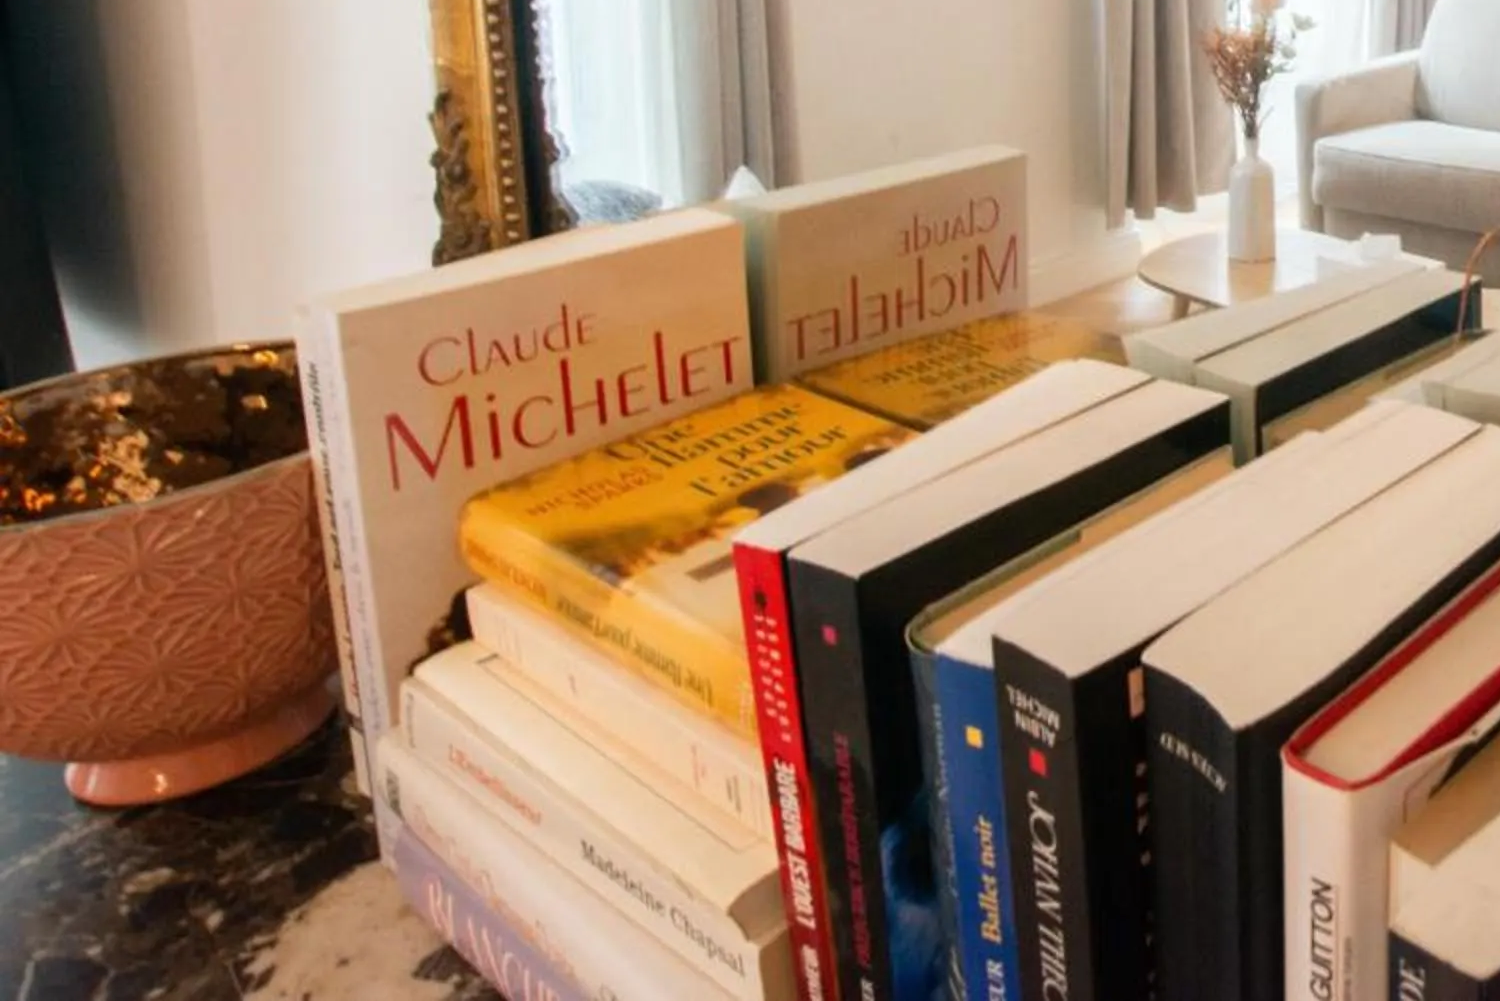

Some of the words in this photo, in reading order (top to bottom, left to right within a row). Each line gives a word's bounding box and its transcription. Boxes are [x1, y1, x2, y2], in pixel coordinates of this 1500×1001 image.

[418, 303, 596, 387] Claude
[384, 330, 742, 490] Michelet
[1005, 684, 1060, 731] MICHEL
[1015, 710, 1055, 748] ALBIN
[773, 758, 806, 853] BARBARE
[973, 814, 996, 868] noir
[787, 849, 816, 930] L'OUEST
[1027, 790, 1063, 922] JOHAN
[580, 837, 666, 917] Madeleine
[669, 905, 747, 979] Chapsal
[978, 873, 1003, 944] Ballet
[1310, 877, 1333, 1001] GUITTON
